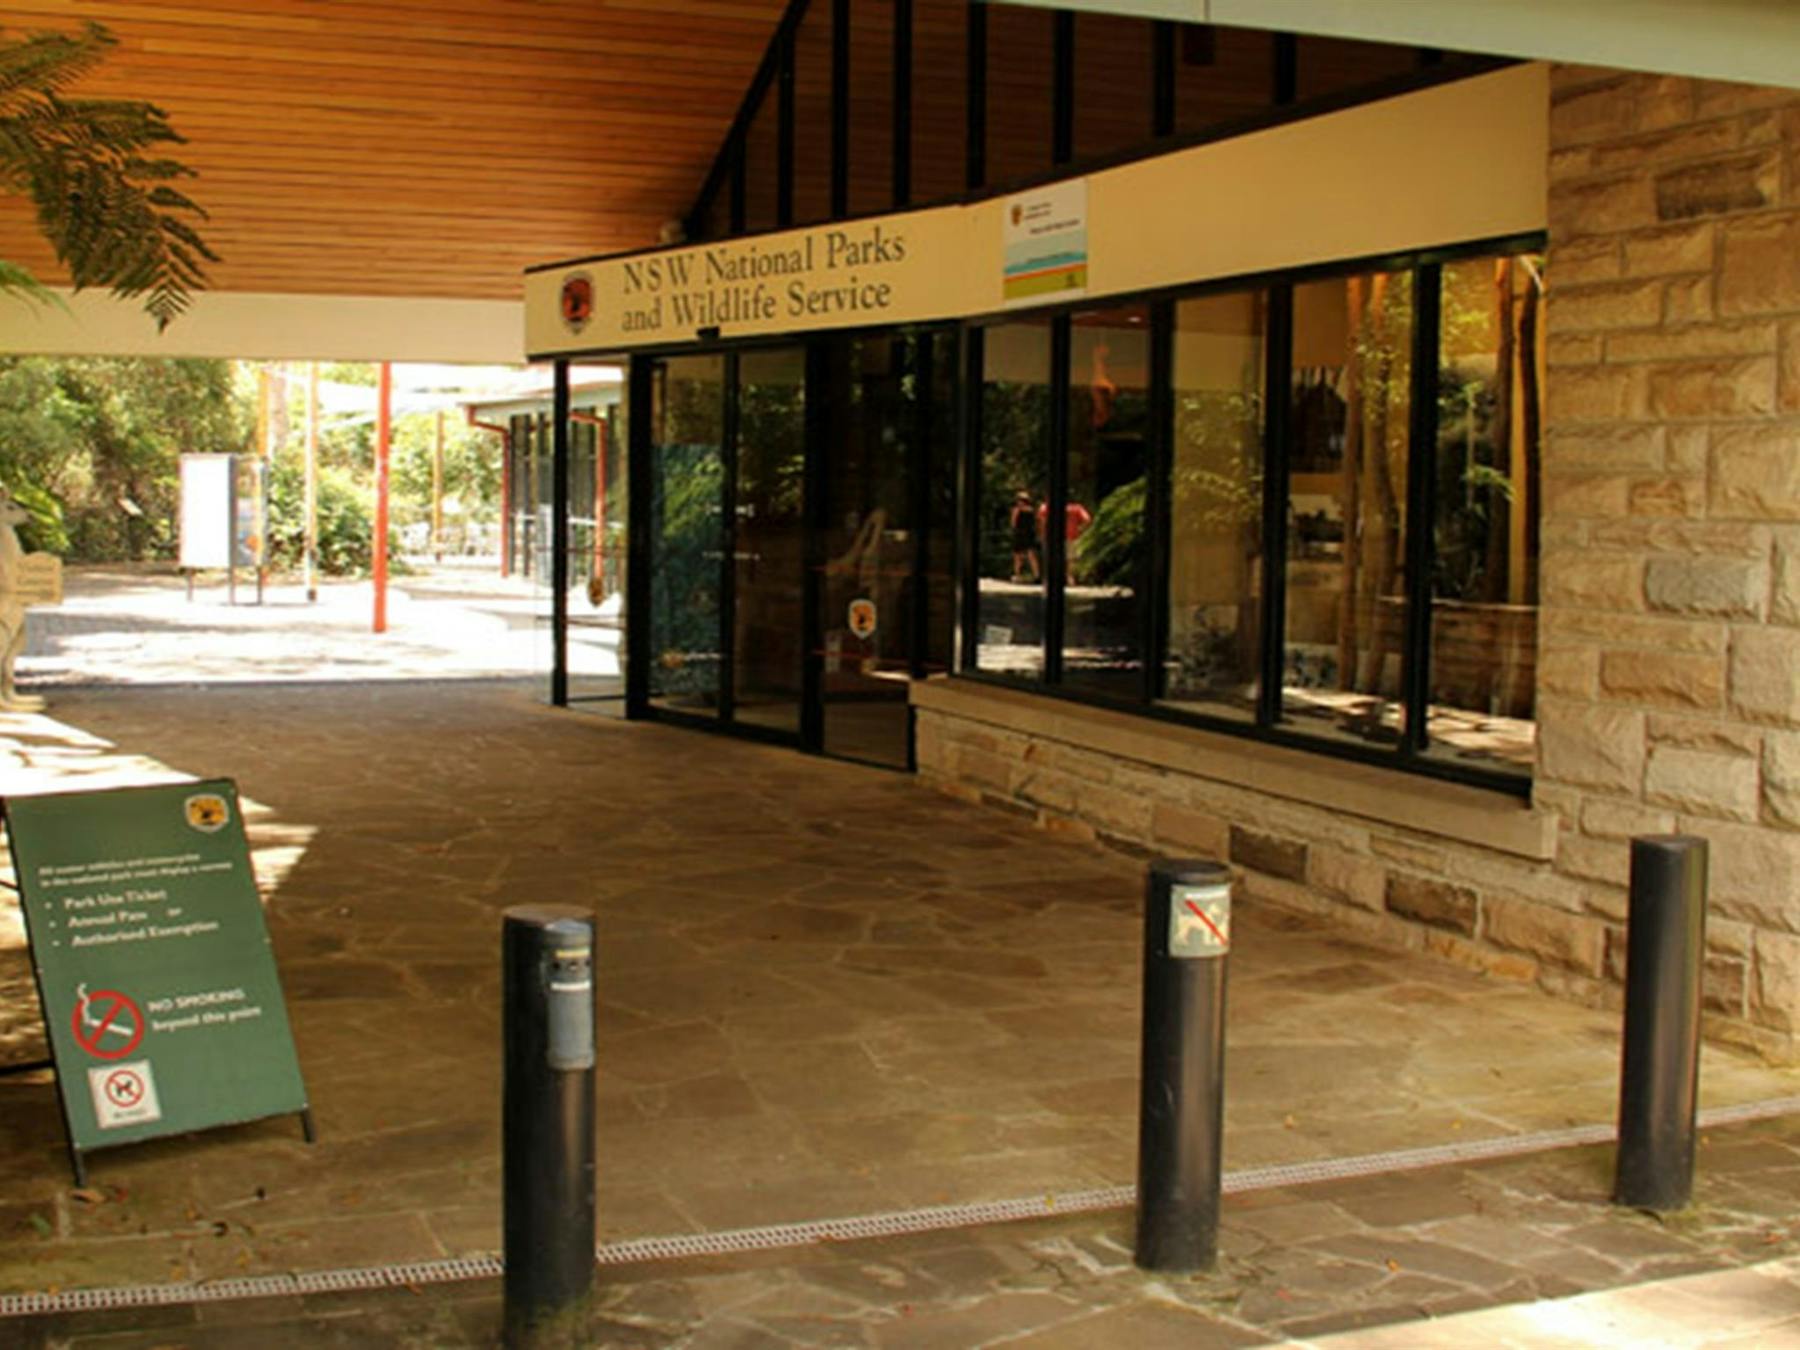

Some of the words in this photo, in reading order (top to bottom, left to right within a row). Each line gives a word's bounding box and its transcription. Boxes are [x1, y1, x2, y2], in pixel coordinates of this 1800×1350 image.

[623, 252, 695, 294] NSW
[705, 234, 813, 285] National
[826, 224, 906, 268] Parks
[621, 294, 662, 331] and
[671, 283, 777, 326] Wildlife
[786, 275, 892, 317] Service
[64, 897, 95, 909] Park
[126, 890, 168, 902] Ticket
[148, 999, 175, 1013] NO
[176, 988, 246, 1008] SMOKING
[152, 1013, 200, 1032] beyond
[201, 1011, 226, 1024] this
